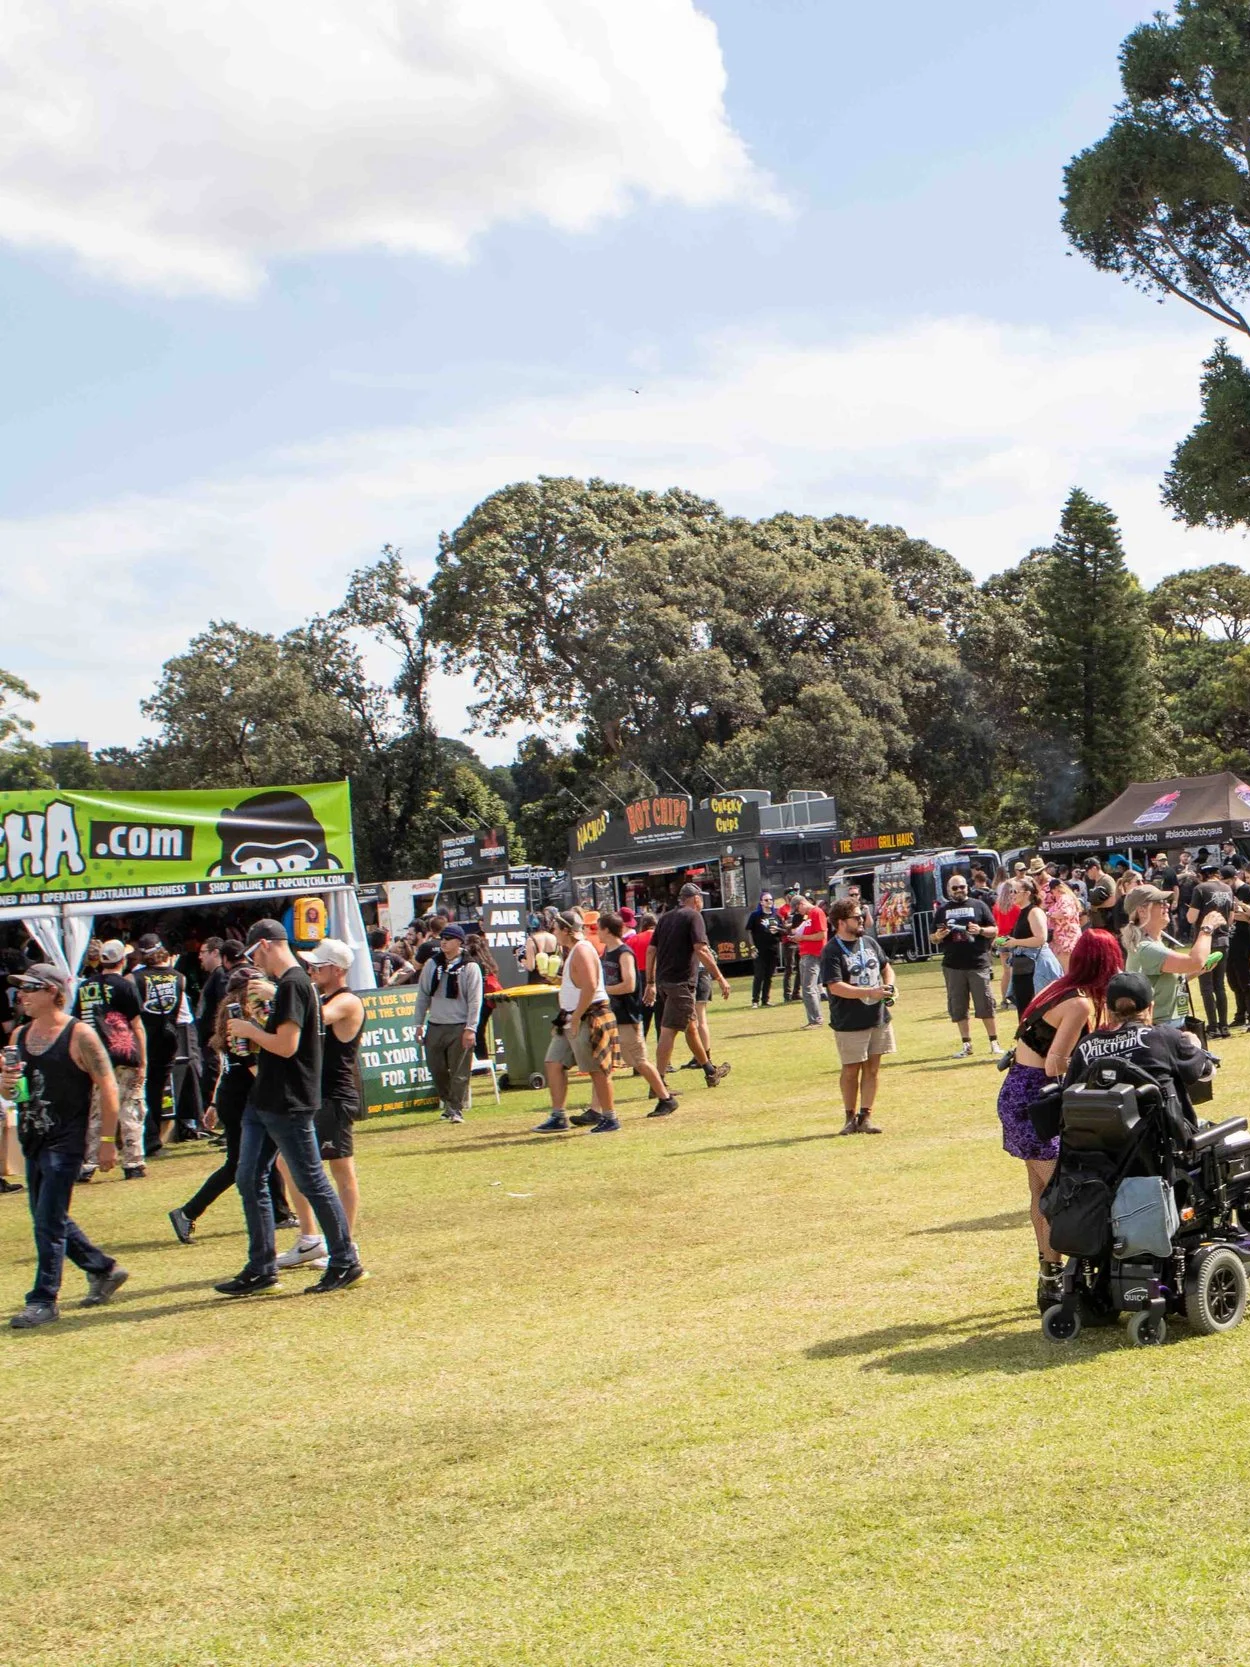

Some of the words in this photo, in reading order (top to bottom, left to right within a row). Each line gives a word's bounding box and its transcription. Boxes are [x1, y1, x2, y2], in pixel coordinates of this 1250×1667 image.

[711, 798, 743, 815] CHEEKY
[626, 800, 651, 835] HOT
[652, 797, 688, 828] CHIPS
[715, 816, 739, 833] CHIPS
[0, 799, 86, 883] HA
[96, 826, 182, 856] .com
[576, 814, 607, 851] NACHOS
[442, 836, 456, 848] FRIED
[840, 840, 852, 853] THE
[878, 834, 896, 848] GRILL
[896, 832, 914, 847] HAUS
[209, 882, 230, 893] SHOP
[232, 879, 263, 892] ONLINE
[265, 879, 276, 889] AT
[277, 874, 345, 889] POPCULTCHA.COM
[510, 872, 529, 880] FRIED
[0, 895, 18, 906] NED
[20, 893, 39, 904] AND
[42, 890, 87, 903] OPERATED
[90, 886, 144, 900] AUSTRALIAN
[147, 884, 186, 897] BUSINESS
[482, 888, 525, 903] FREE
[490, 910, 520, 925] AIR
[486, 932, 525, 947] TATS
[362, 996, 377, 1007] N'T
[379, 994, 398, 1005] LOSE
[400, 992, 418, 1003] YOU
[366, 1009, 377, 1019] IN
[378, 1007, 395, 1018] THE
[395, 1005, 416, 1017] CRO
[360, 1027, 399, 1047] WE'LL
[1079, 1027, 1152, 1066] VALENTINE
[362, 1051, 380, 1068] TO
[383, 1046, 419, 1065] YOUR
[381, 1069, 406, 1087] FOR
[409, 1066, 433, 1083] FRE
[368, 1104, 382, 1114] SHOP
